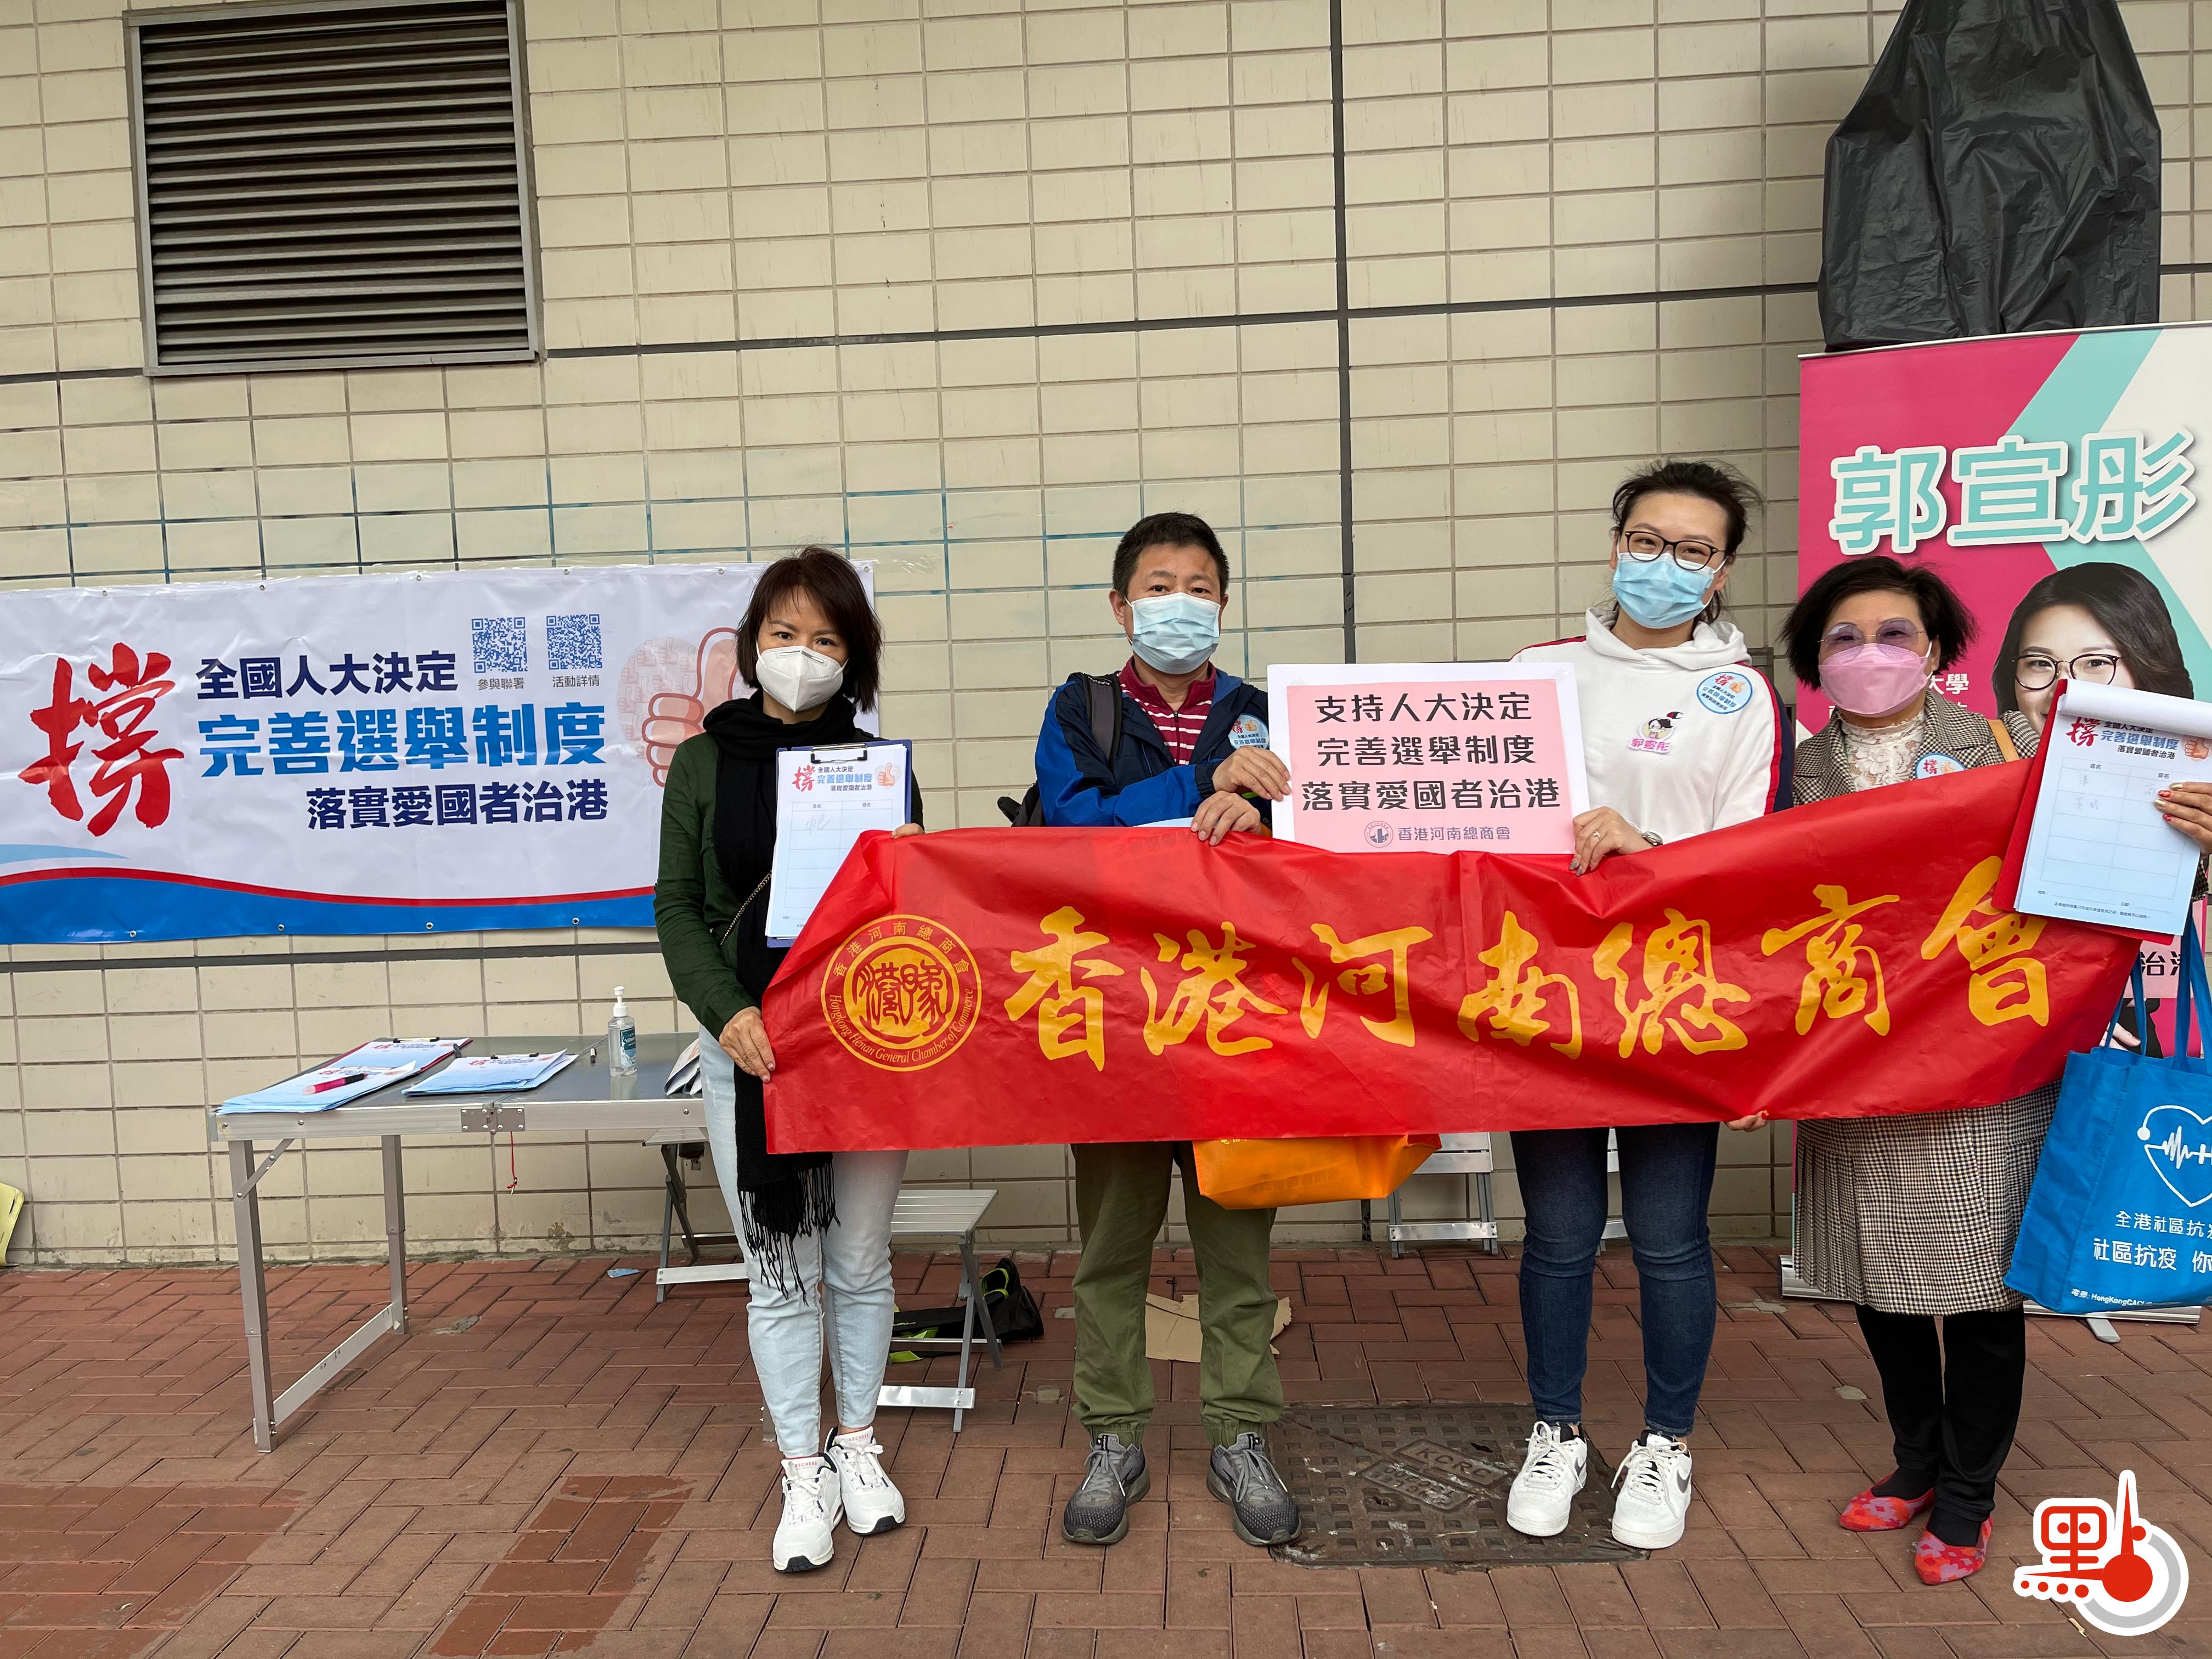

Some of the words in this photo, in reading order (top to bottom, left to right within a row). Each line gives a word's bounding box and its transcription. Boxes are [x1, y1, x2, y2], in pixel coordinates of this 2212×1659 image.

[1835, 431, 2190, 549] 郭宣彤
[196, 651, 459, 699] 全國人大決定
[477, 678, 525, 690] 參與聯署
[552, 675, 600, 688] 活動詳情
[1314, 691, 1532, 724] 支持人大決定
[198, 702, 606, 777] 完善選舉制度
[2101, 730, 2180, 750] 完善選舉制度
[2104, 721, 2153, 733] 全國人大決定
[1317, 735, 1537, 766] 完善選舉制度
[2117, 744, 2176, 759] 落實愛國者治港
[817, 774, 873, 784] 完善選舉制度
[306, 779, 608, 830] 落實愛國者治港
[1301, 778, 1561, 811] 落實愛國者治港
[1398, 826, 1510, 840] 香港河南總商會
[833, 921, 969, 978] 香港河南總商會
[1003, 855, 2050, 1071] 香港河南總商會
[830, 994, 852, 1037] Hongkong
[952, 988, 974, 1032] Commerce
[848, 1031, 875, 1056] Henan
[912, 1037, 948, 1062] Chamber
[947, 1029, 959, 1042] of
[876, 1047, 909, 1063] General
[2093, 1238, 2177, 1271] 社區抗疫
[1416, 1448, 1492, 1477] KCRC
